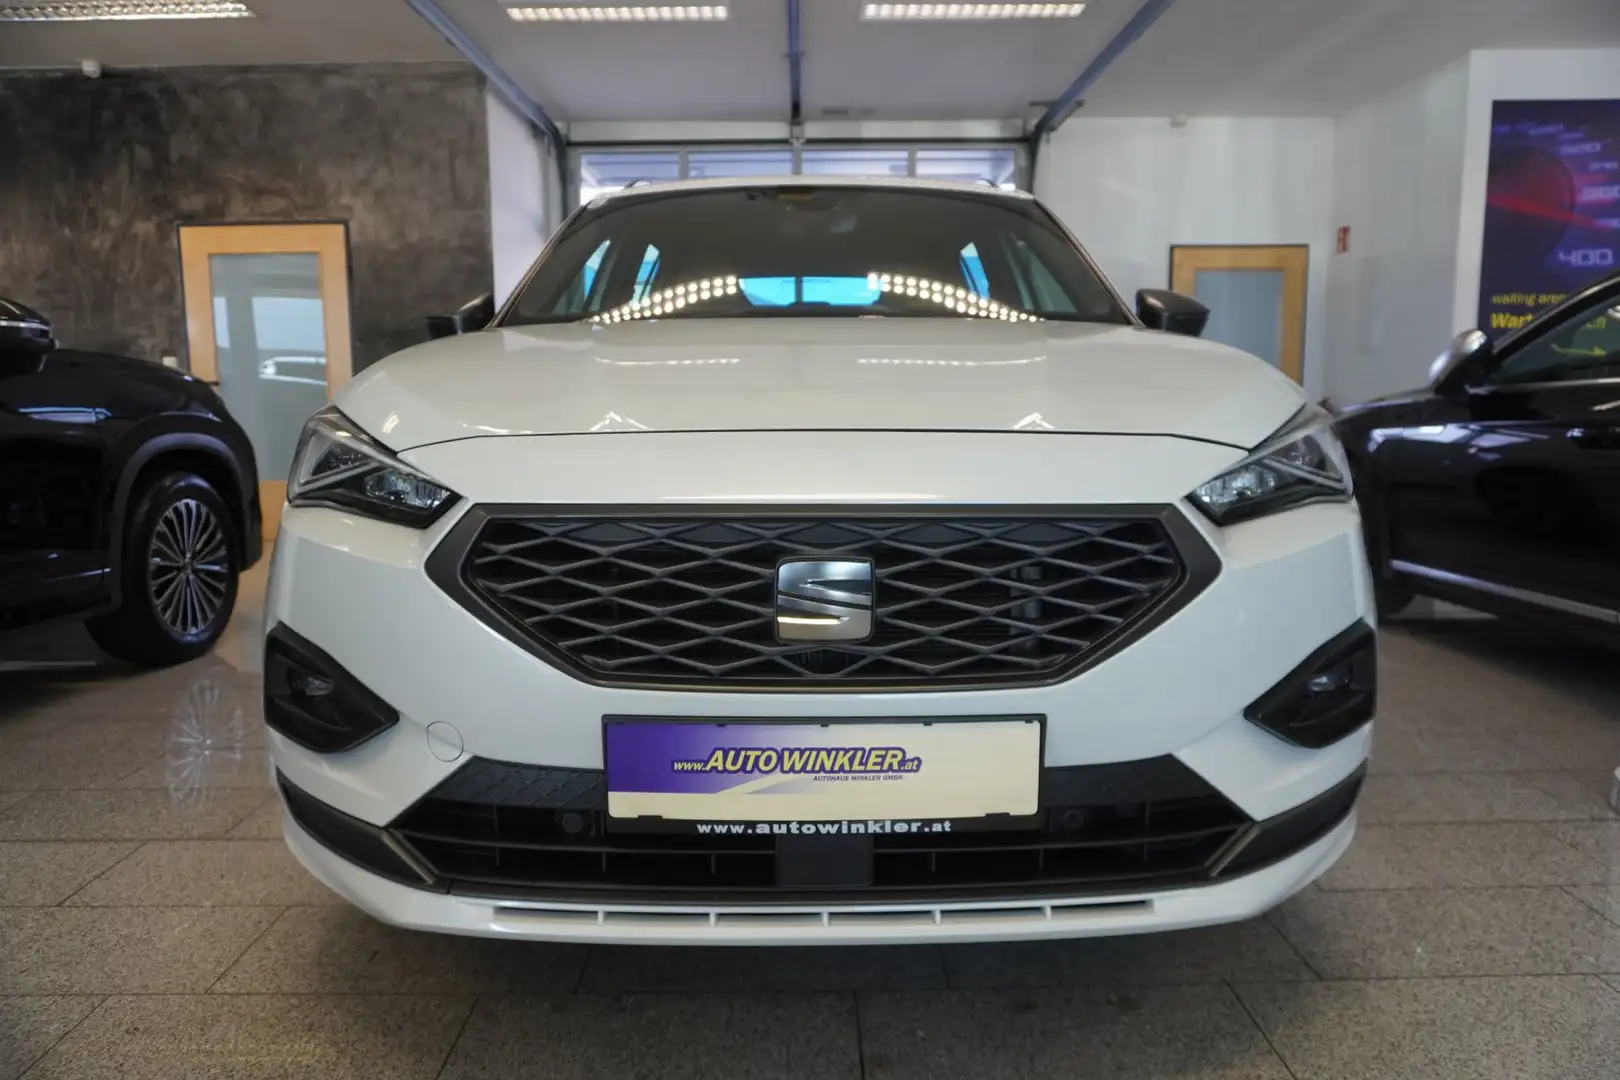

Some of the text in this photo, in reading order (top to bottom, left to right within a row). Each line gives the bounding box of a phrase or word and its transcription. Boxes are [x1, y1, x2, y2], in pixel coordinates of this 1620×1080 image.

[1559, 249, 1613, 266] 400
[1491, 292, 1535, 306] waiting
[696, 820, 952, 834] www.autowinkler.at
